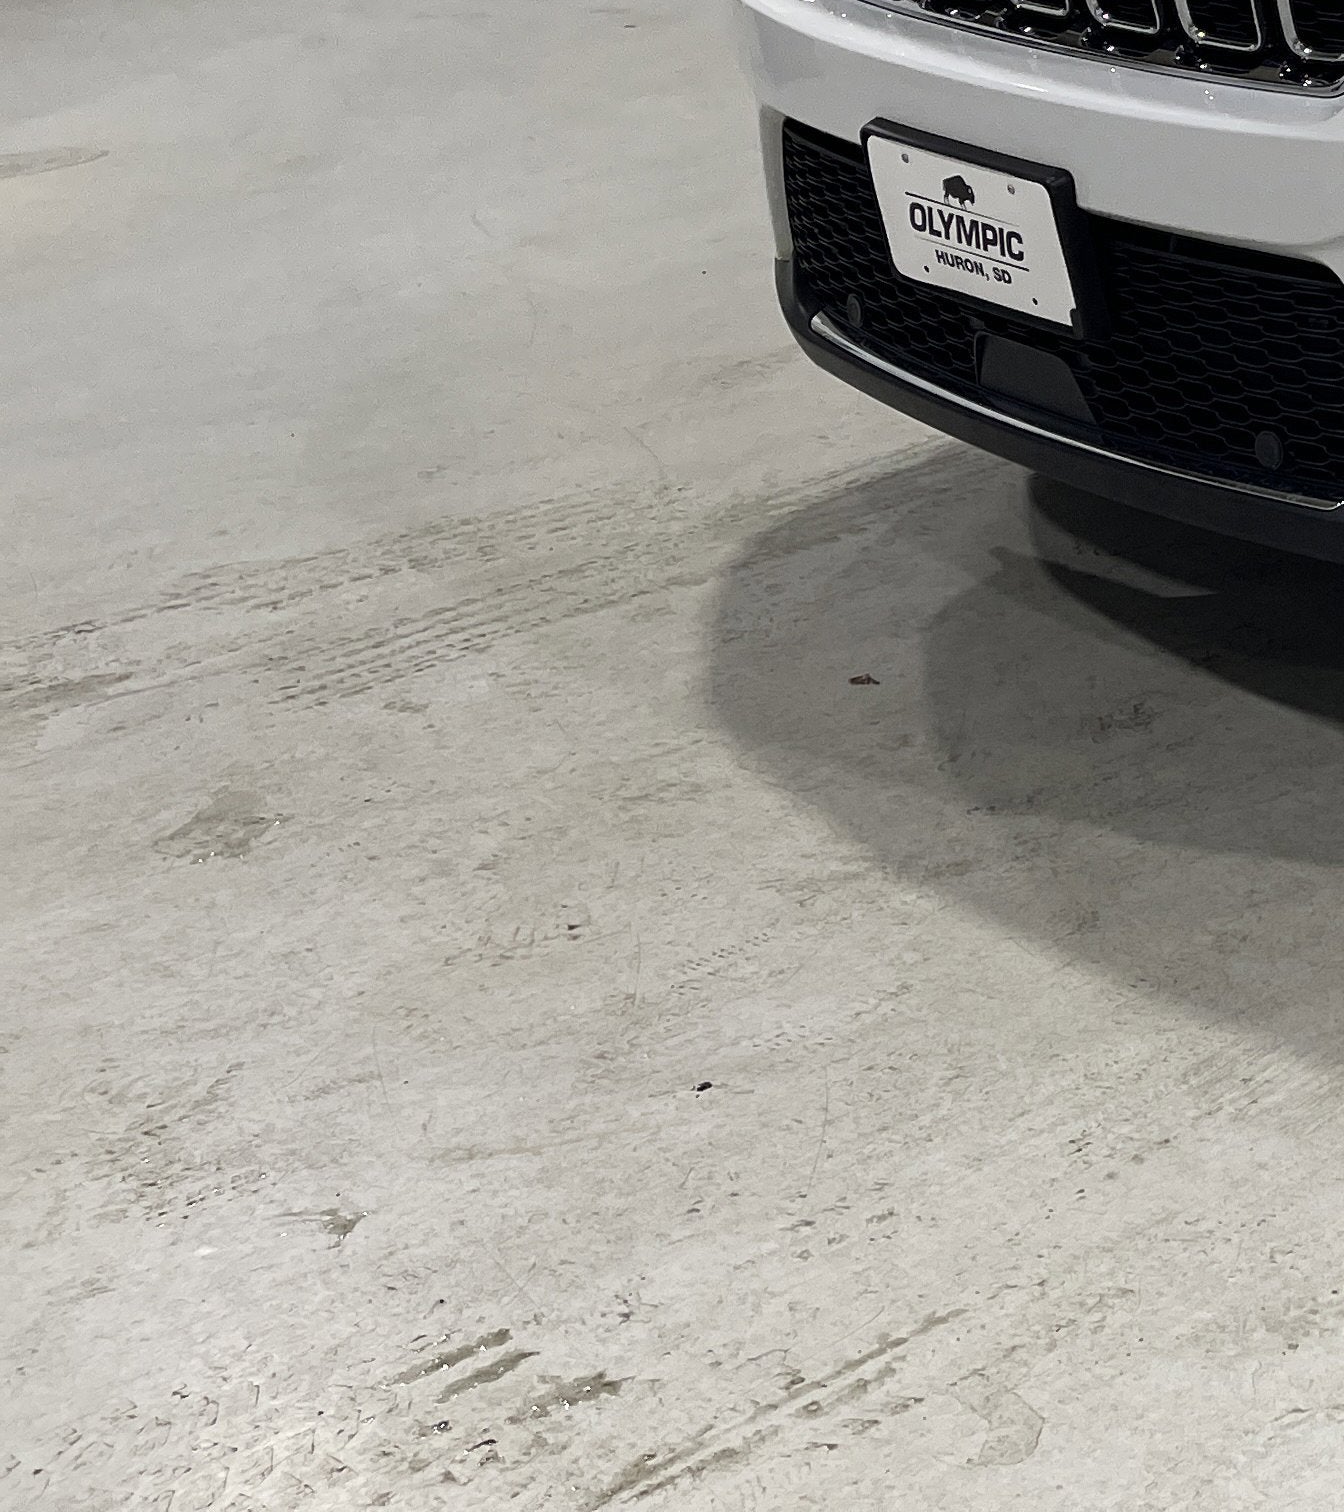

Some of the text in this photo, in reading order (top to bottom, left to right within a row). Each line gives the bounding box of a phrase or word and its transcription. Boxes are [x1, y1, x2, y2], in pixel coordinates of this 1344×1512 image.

[909, 202, 1025, 262] OLYMPIC
[935, 249, 1013, 284] HURON, SD
